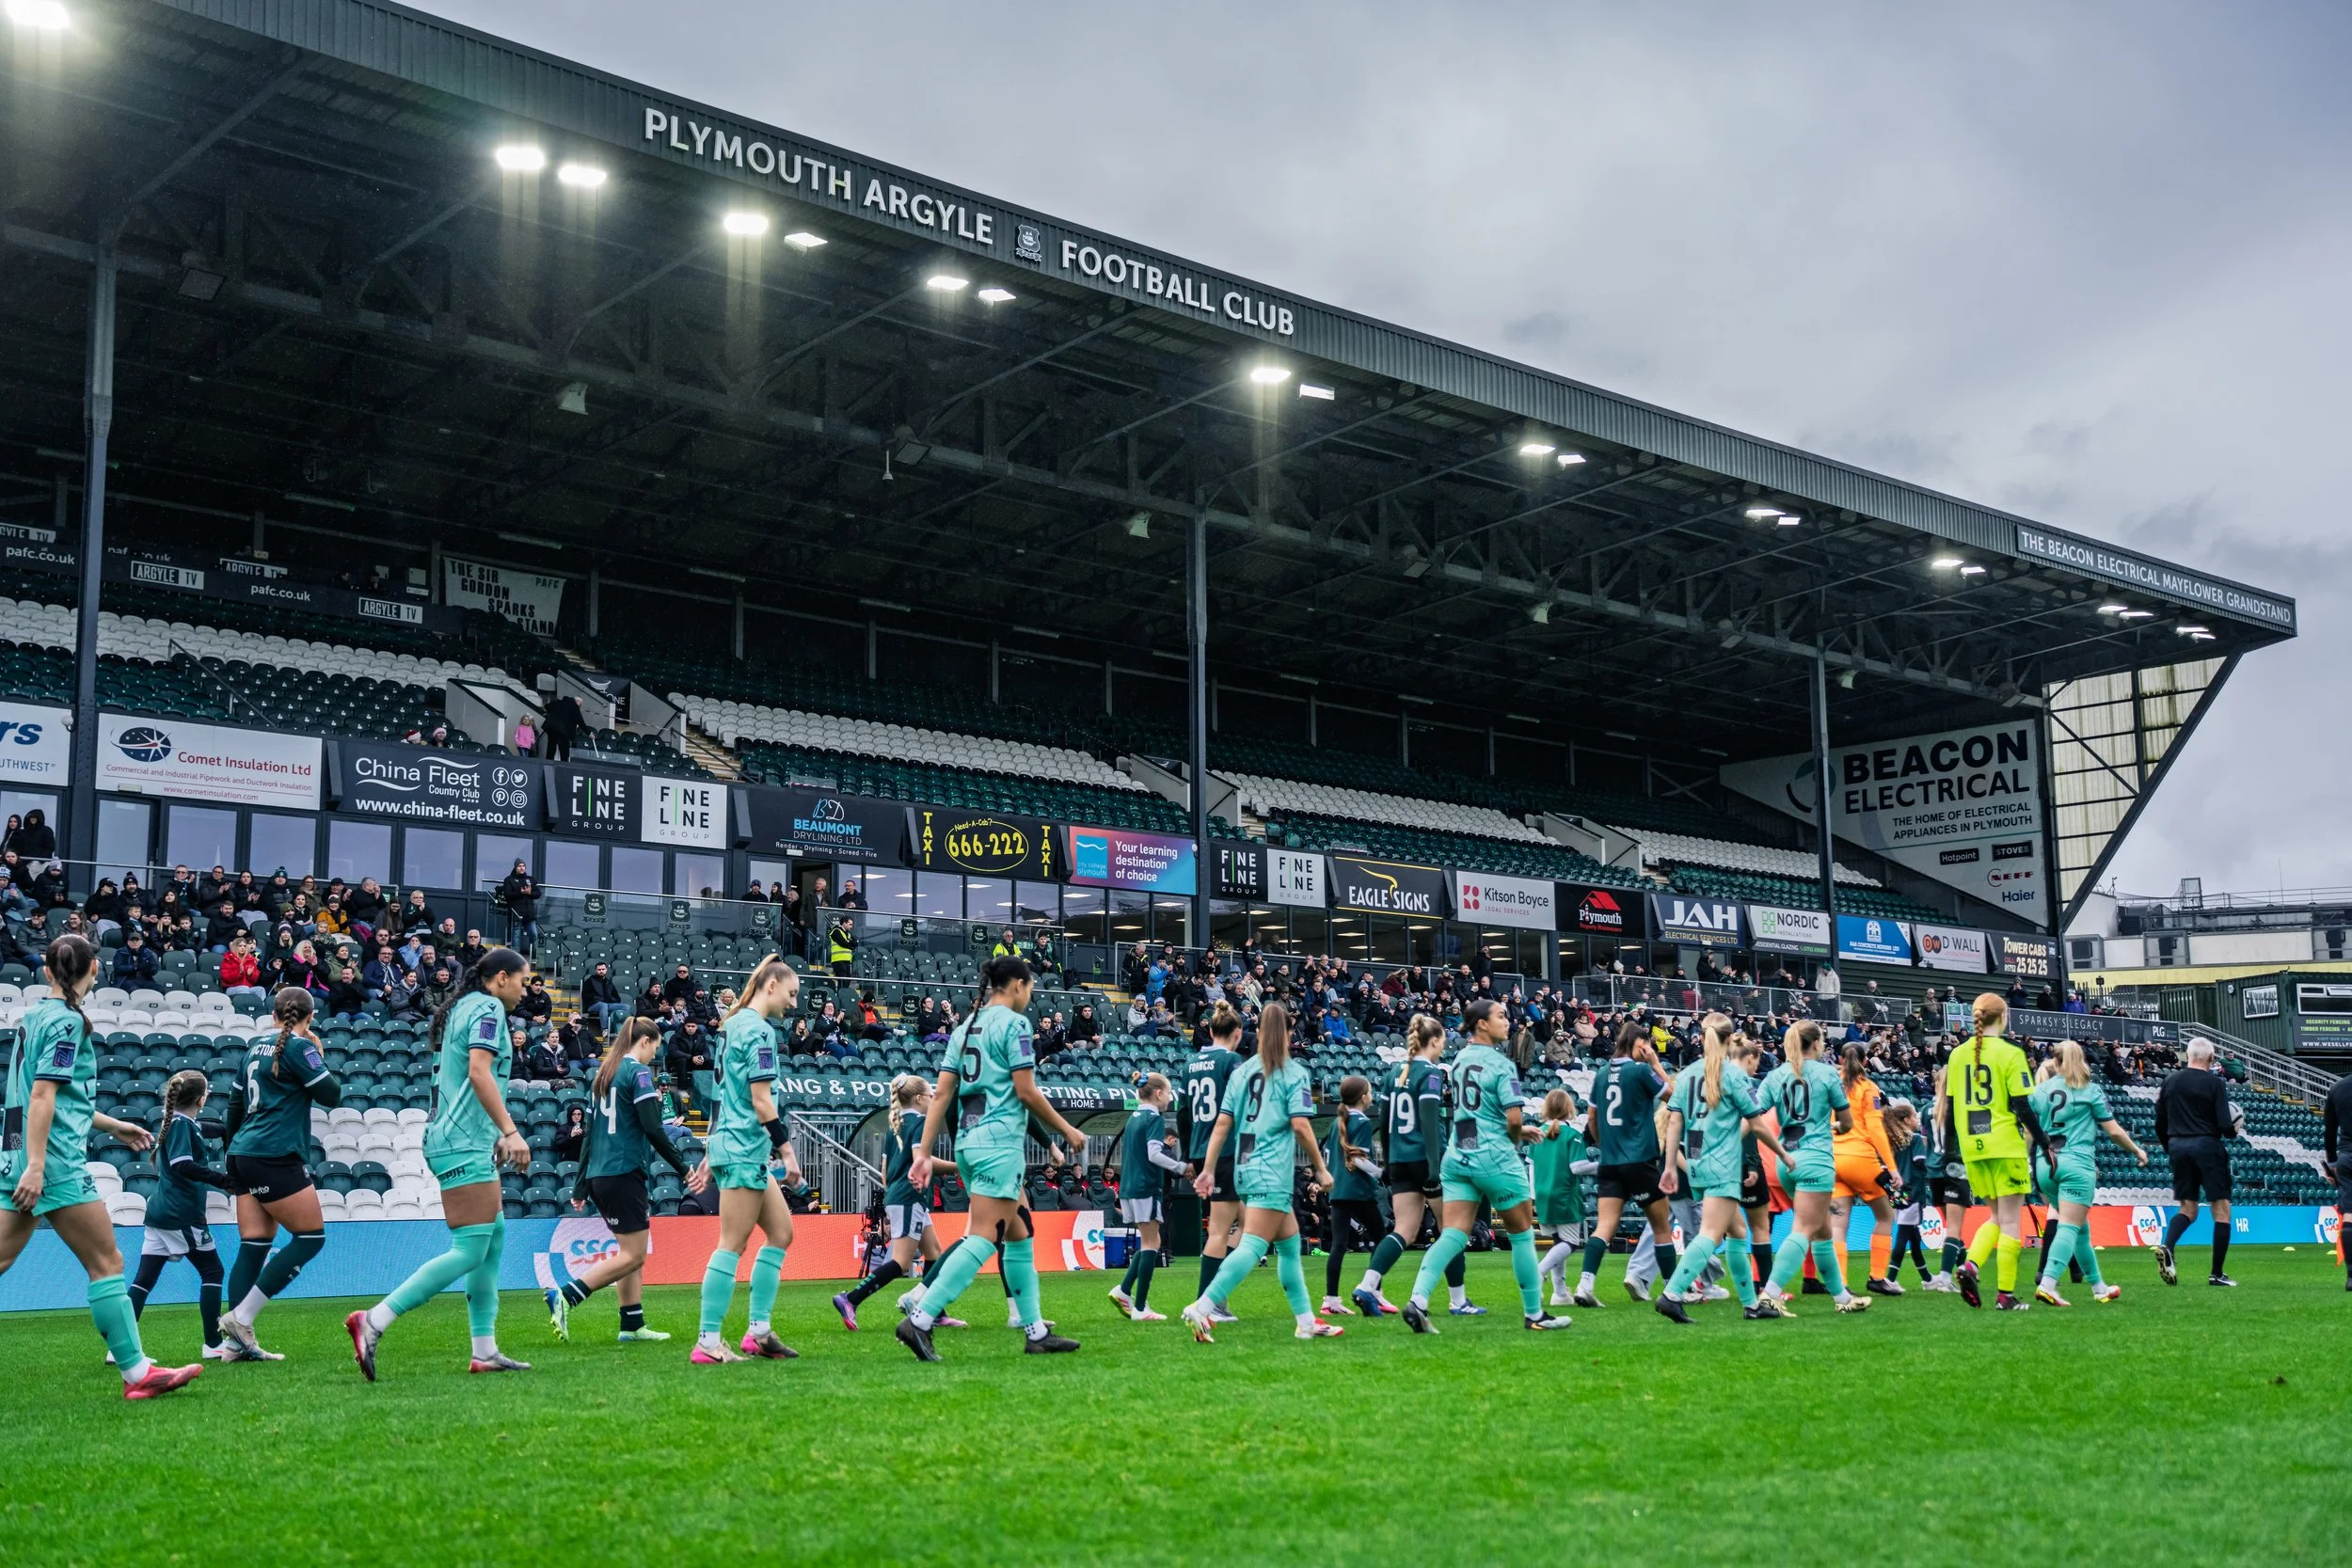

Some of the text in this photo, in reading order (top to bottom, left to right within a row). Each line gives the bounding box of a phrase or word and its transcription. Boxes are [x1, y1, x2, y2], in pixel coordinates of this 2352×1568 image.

[644, 107, 993, 245] PLYMOUTH ARGYLE
[1061, 239, 1295, 336] FOOTBALL CLUB
[6, 546, 75, 565] pafc.co.uk
[136, 564, 198, 586] ARGYLE TV
[450, 560, 499, 583] THE SIR
[2021, 531, 2291, 624] THE BEACON ELECTRICAL MAYFLOWER GRANDSTAND
[461, 579, 510, 600] GORDON
[535, 577, 559, 589] PAFC
[250, 584, 310, 602] pafc.co.uk
[363, 600, 417, 621] ARGYLE TV
[487, 598, 535, 618] SPARKS
[517, 617, 555, 635] STAND
[178, 752, 311, 776] Comet Insulation Ltd
[1843, 729, 2028, 785] BEACON
[106, 763, 312, 791] Commercial and Industrial Pipework and Ductwork Insulation
[355, 757, 480, 788] China Fleet
[164, 784, 259, 800] www.cometinsulation.com
[428, 784, 480, 799] Country Club
[1845, 768, 2030, 815] ELECTRICAL
[355, 799, 525, 826] www.china-fleet.co.uk
[1893, 801, 2031, 827] THE HOME OF ELECTRICAL
[571, 820, 625, 832] GROUP
[659, 829, 709, 840] GROUP
[793, 818, 863, 836] BEAUMONT
[1893, 815, 2032, 840] APPLIANCES IN PLYMOUTH
[793, 830, 863, 846] DRYLINING LTD
[923, 812, 933, 865] TAXI
[948, 832, 1025, 858] 666-222
[775, 841, 799, 850] Render
[803, 845, 833, 855] Drylining
[838, 848, 860, 857] Screed
[1041, 825, 1051, 878] TAXI
[1115, 840, 1178, 860] Your learning
[1942, 851, 1977, 863] Hotpoint
[1994, 846, 2028, 856] STOVES
[1077, 867, 1106, 877] plymouth
[1115, 855, 1168, 870] destination
[1115, 867, 1158, 882] of choice
[1221, 886, 1258, 895] GROUP
[1348, 885, 1430, 912] EAGLE SIGNS
[1484, 887, 1549, 909] Kitson Boyce
[2002, 890, 2035, 902] Haier
[1503, 908, 1530, 916] SERVICES
[1664, 900, 1738, 931] JAH
[1776, 912, 1820, 929] NORDIC
[1665, 931, 1738, 944] ELECTRICAL SERVICES LTD
[1777, 930, 1813, 939] INSTALLATIONS
[1942, 936, 1980, 953] D WALL
[2028, 942, 2047, 957] CABS
[2016, 957, 2026, 974] 25
[2027, 958, 2037, 974] 25
[2038, 958, 2048, 976] 25
[2019, 1014, 2104, 1031] SPARKSY'S LEGACY
[2153, 1025, 2165, 1037] PLG
[962, 1026, 983, 1083] 5
[1188, 1060, 1216, 1073] FRANCIS
[246, 1060, 261, 1115] 6
[829, 1080, 847, 1096] &
[1965, 1064, 1994, 1105] 13
[1070, 1099, 1095, 1108] HOME
[1187, 1077, 1217, 1123] 23
[1246, 1072, 1265, 1122] 8
[1606, 1085, 1624, 1126] 2
[1781, 1079, 1811, 1122] 10
[1388, 1091, 1415, 1134] 19
[2049, 1089, 2067, 1128] 2
[445, 1167, 466, 1180] PJH
[2139, 1218, 2156, 1233] SSG
[2235, 1217, 2249, 1232] HR
